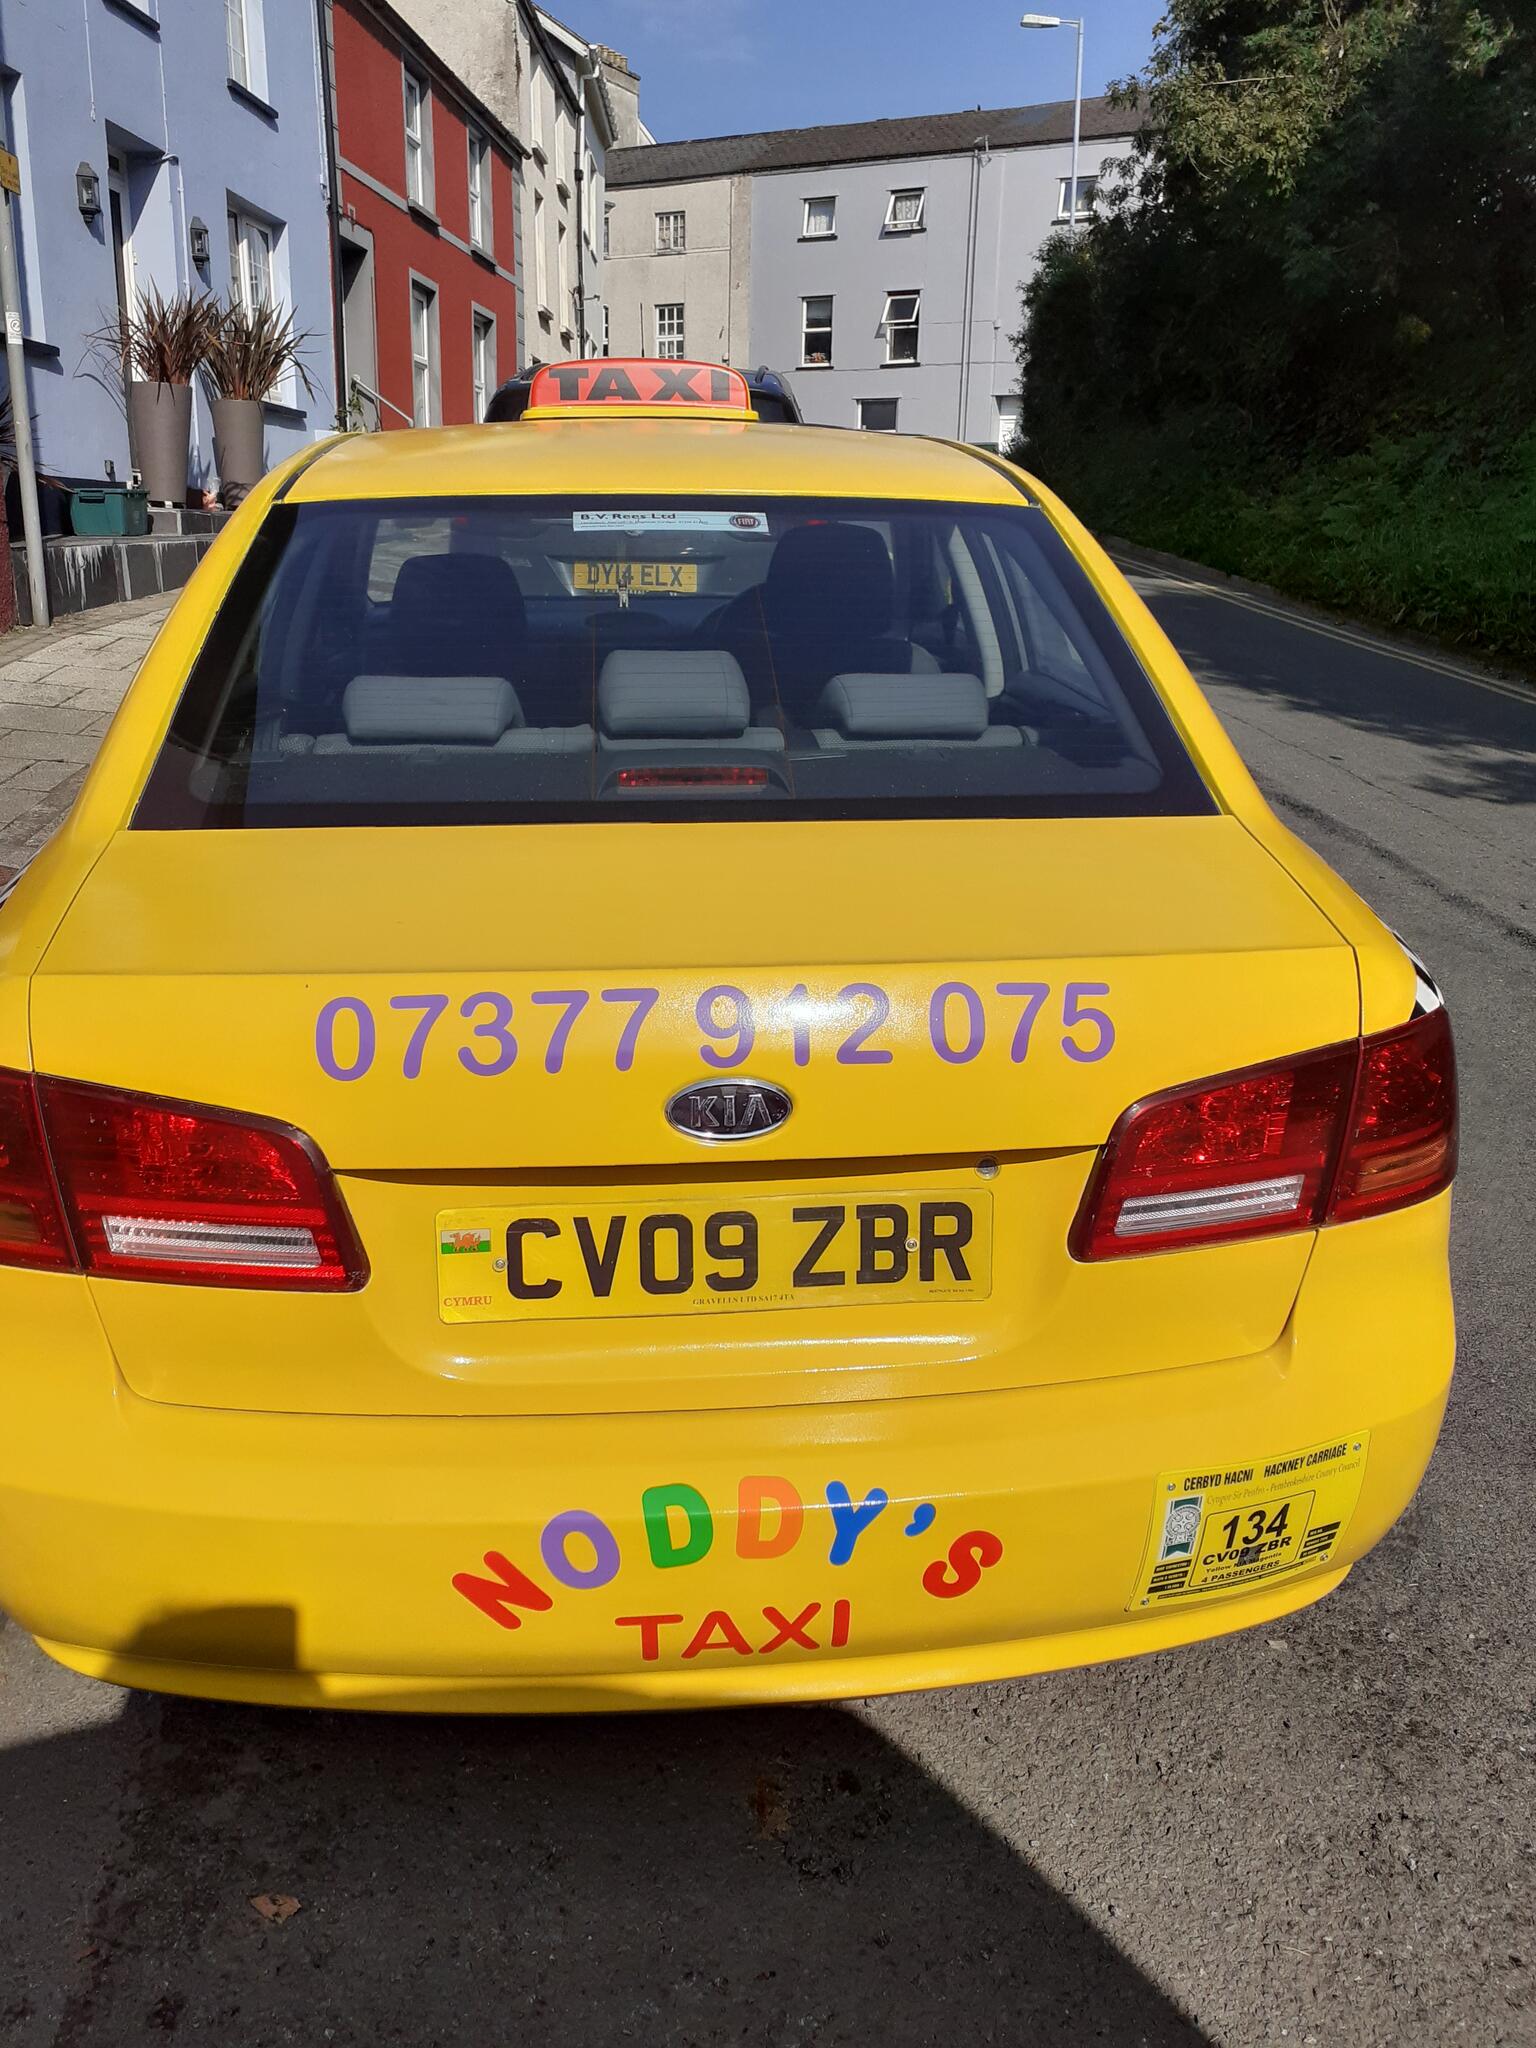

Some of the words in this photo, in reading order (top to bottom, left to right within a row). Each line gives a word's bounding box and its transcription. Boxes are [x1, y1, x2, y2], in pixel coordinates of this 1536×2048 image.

[549, 368, 730, 401] TAXI
[640, 565, 683, 587] ELX
[315, 988, 660, 1082] 07377
[696, 982, 894, 1069] 912
[929, 982, 1116, 1065] 075
[689, 1093, 774, 1129] KIA
[506, 1210, 759, 1300] CV09
[792, 1201, 973, 1288] ZBR
[443, 1296, 493, 1307] CYMRU
[1184, 1473, 1222, 1491] CERBYD
[1224, 1468, 1254, 1485] HACNI
[1263, 1456, 1306, 1478] HACKNEY
[1306, 1443, 1348, 1467] CARRIAGE
[1222, 1503, 1291, 1550] 134
[451, 1475, 1004, 1630] NODDY'S
[1202, 1546, 1250, 1566] CV09
[1254, 1536, 1293, 1556] ZBR
[1206, 1565, 1231, 1574] Yellow
[1210, 1559, 1281, 1582] PASSENGERS
[614, 1599, 851, 1661] TAXI
